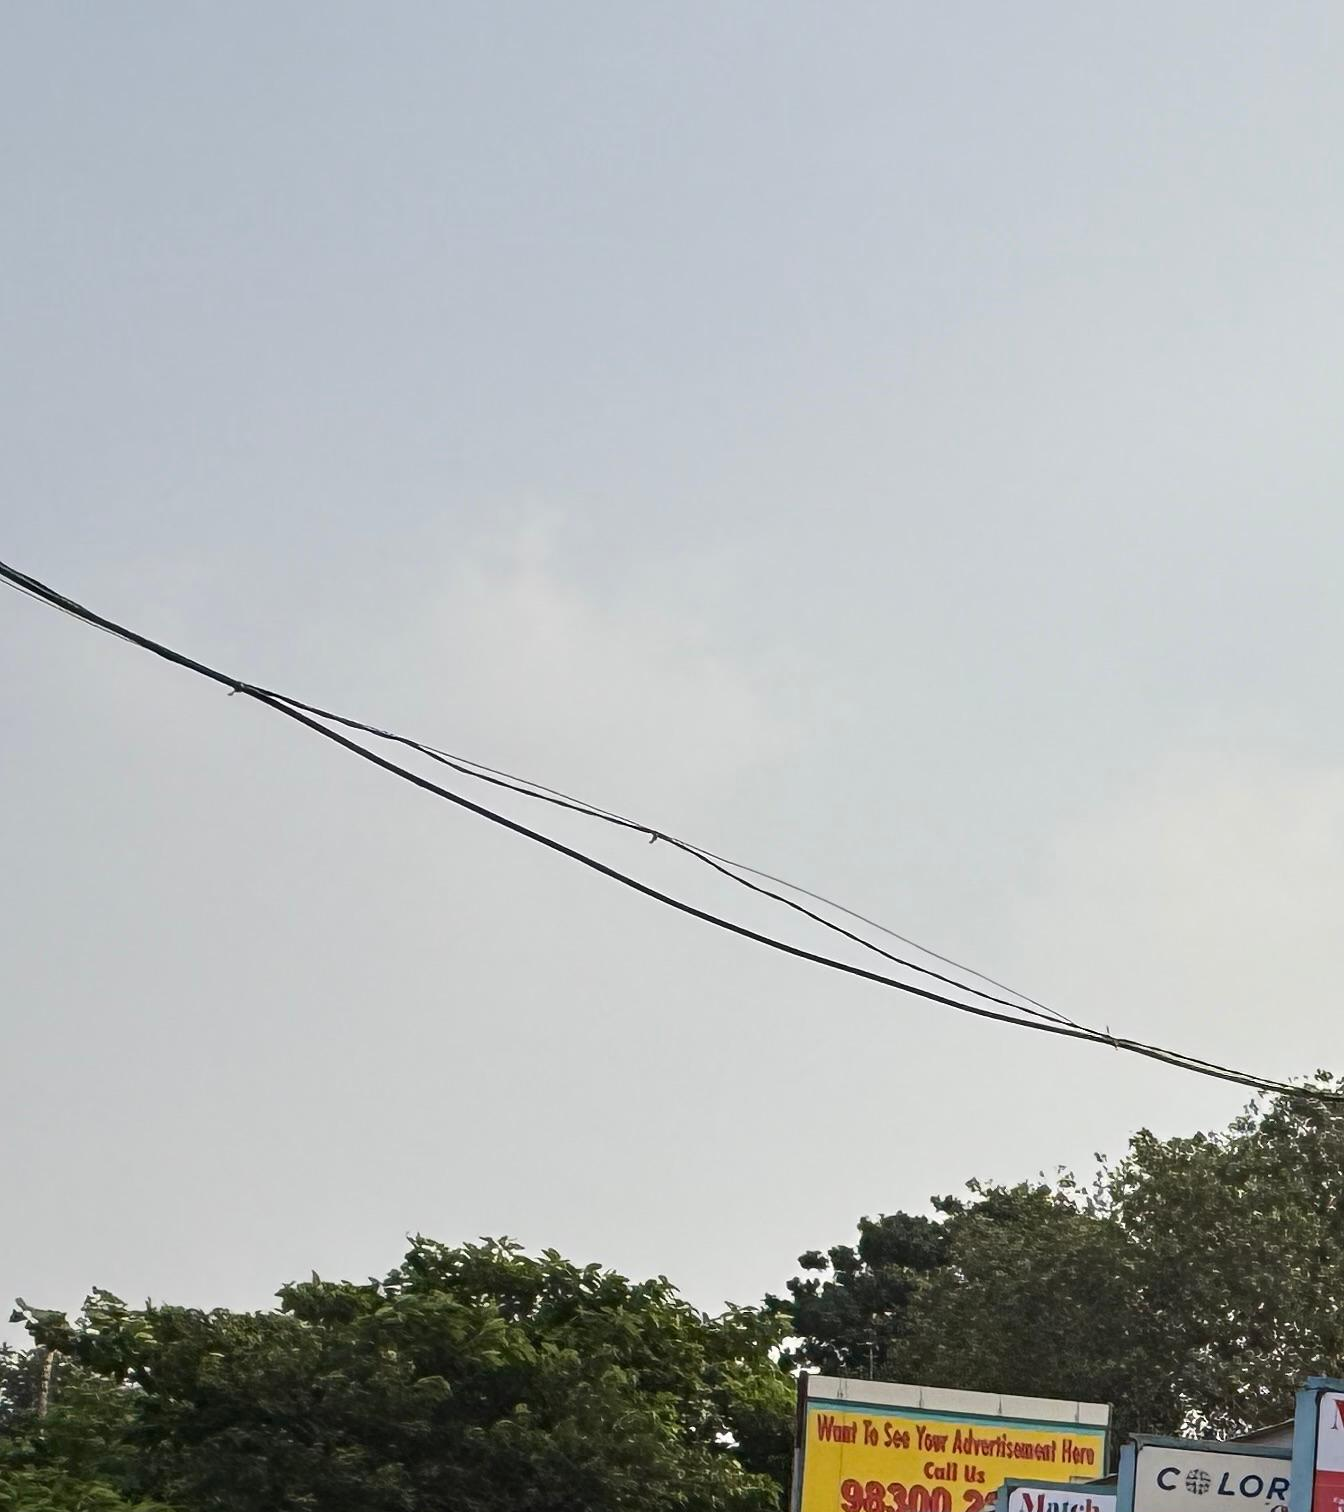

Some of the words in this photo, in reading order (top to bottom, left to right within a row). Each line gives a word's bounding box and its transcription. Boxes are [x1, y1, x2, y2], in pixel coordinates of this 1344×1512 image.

[817, 1414, 857, 1445] Want
[863, 1419, 879, 1447] To
[884, 1421, 911, 1450] See
[916, 1424, 948, 1454] Your
[952, 1428, 1056, 1463] Advertisement
[923, 1461, 958, 1483] Call
[964, 1465, 986, 1484] Us
[1156, 1466, 1290, 1501] COLOR
